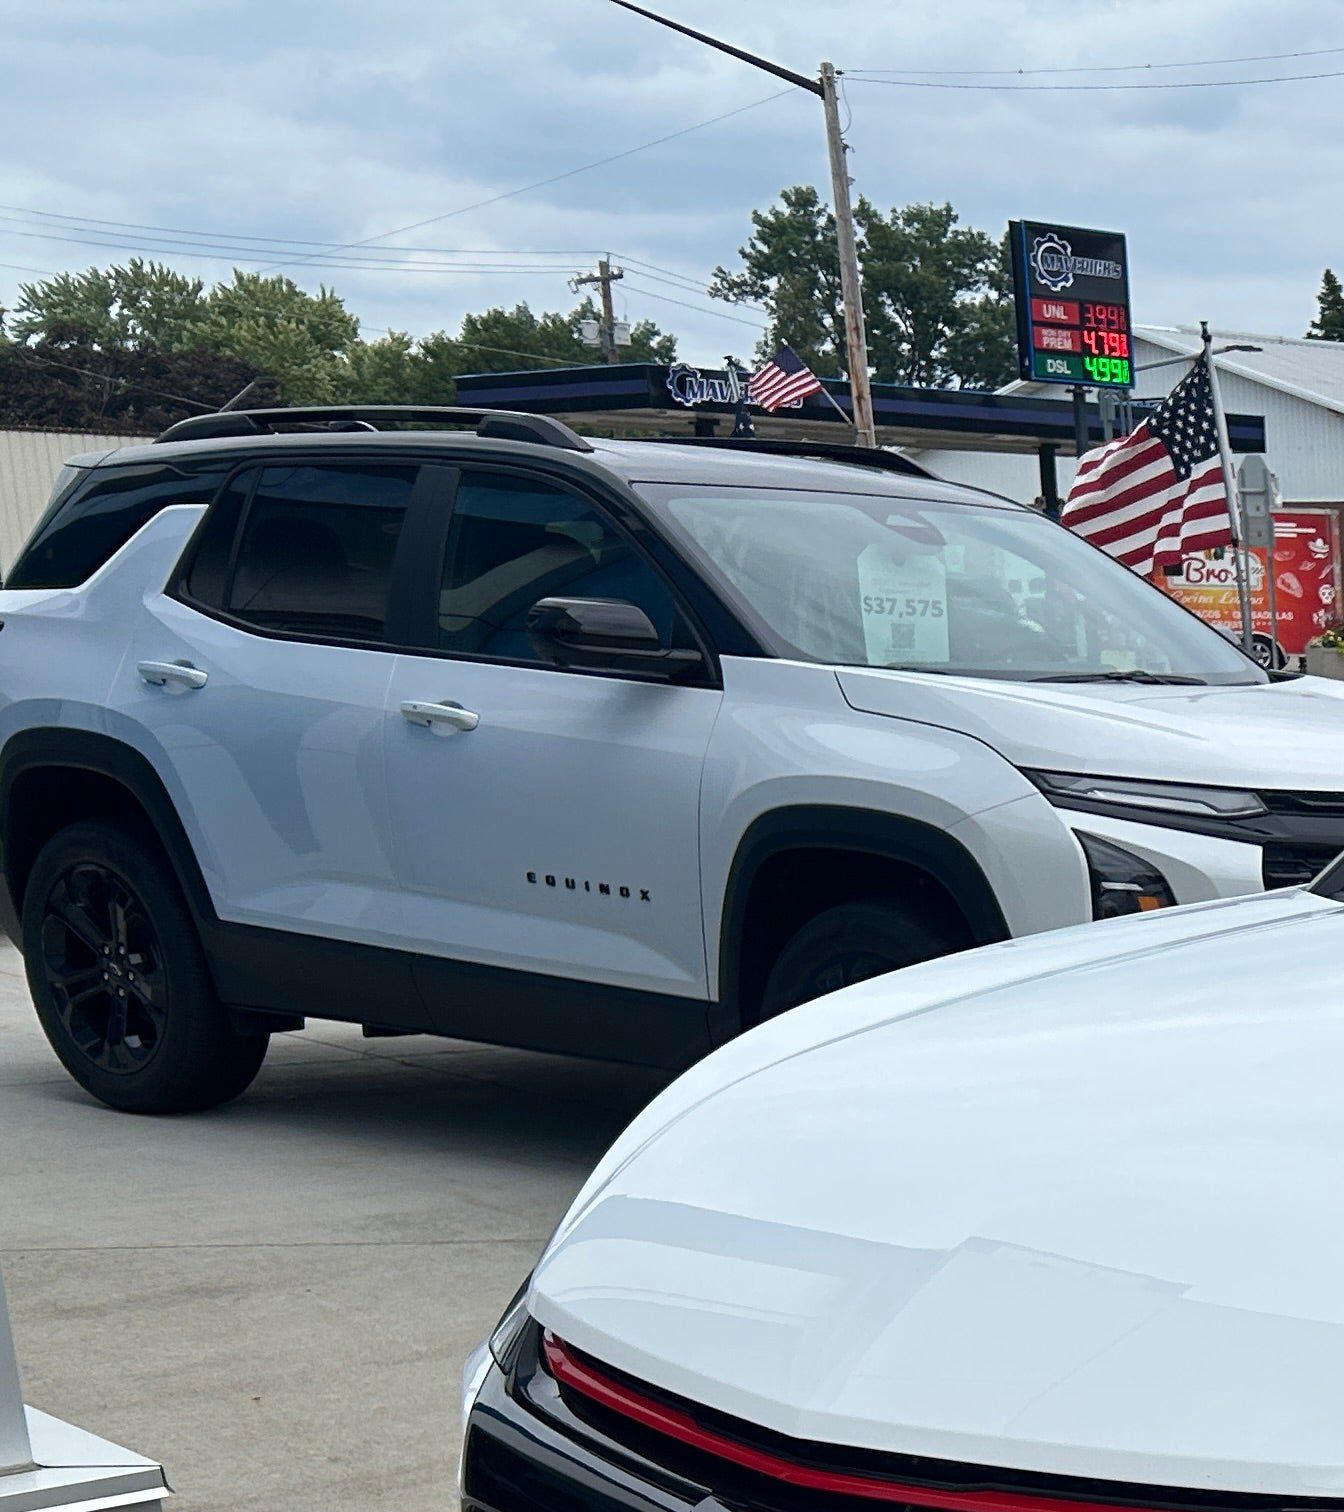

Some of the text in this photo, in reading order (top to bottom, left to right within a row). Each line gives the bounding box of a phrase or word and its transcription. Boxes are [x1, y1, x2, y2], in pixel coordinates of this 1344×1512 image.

[1043, 304, 1068, 320] UNL
[1043, 337, 1073, 351] PREM
[1046, 359, 1071, 374] DSL
[862, 594, 945, 619] $37,575
[526, 871, 651, 902] EQUINOX
